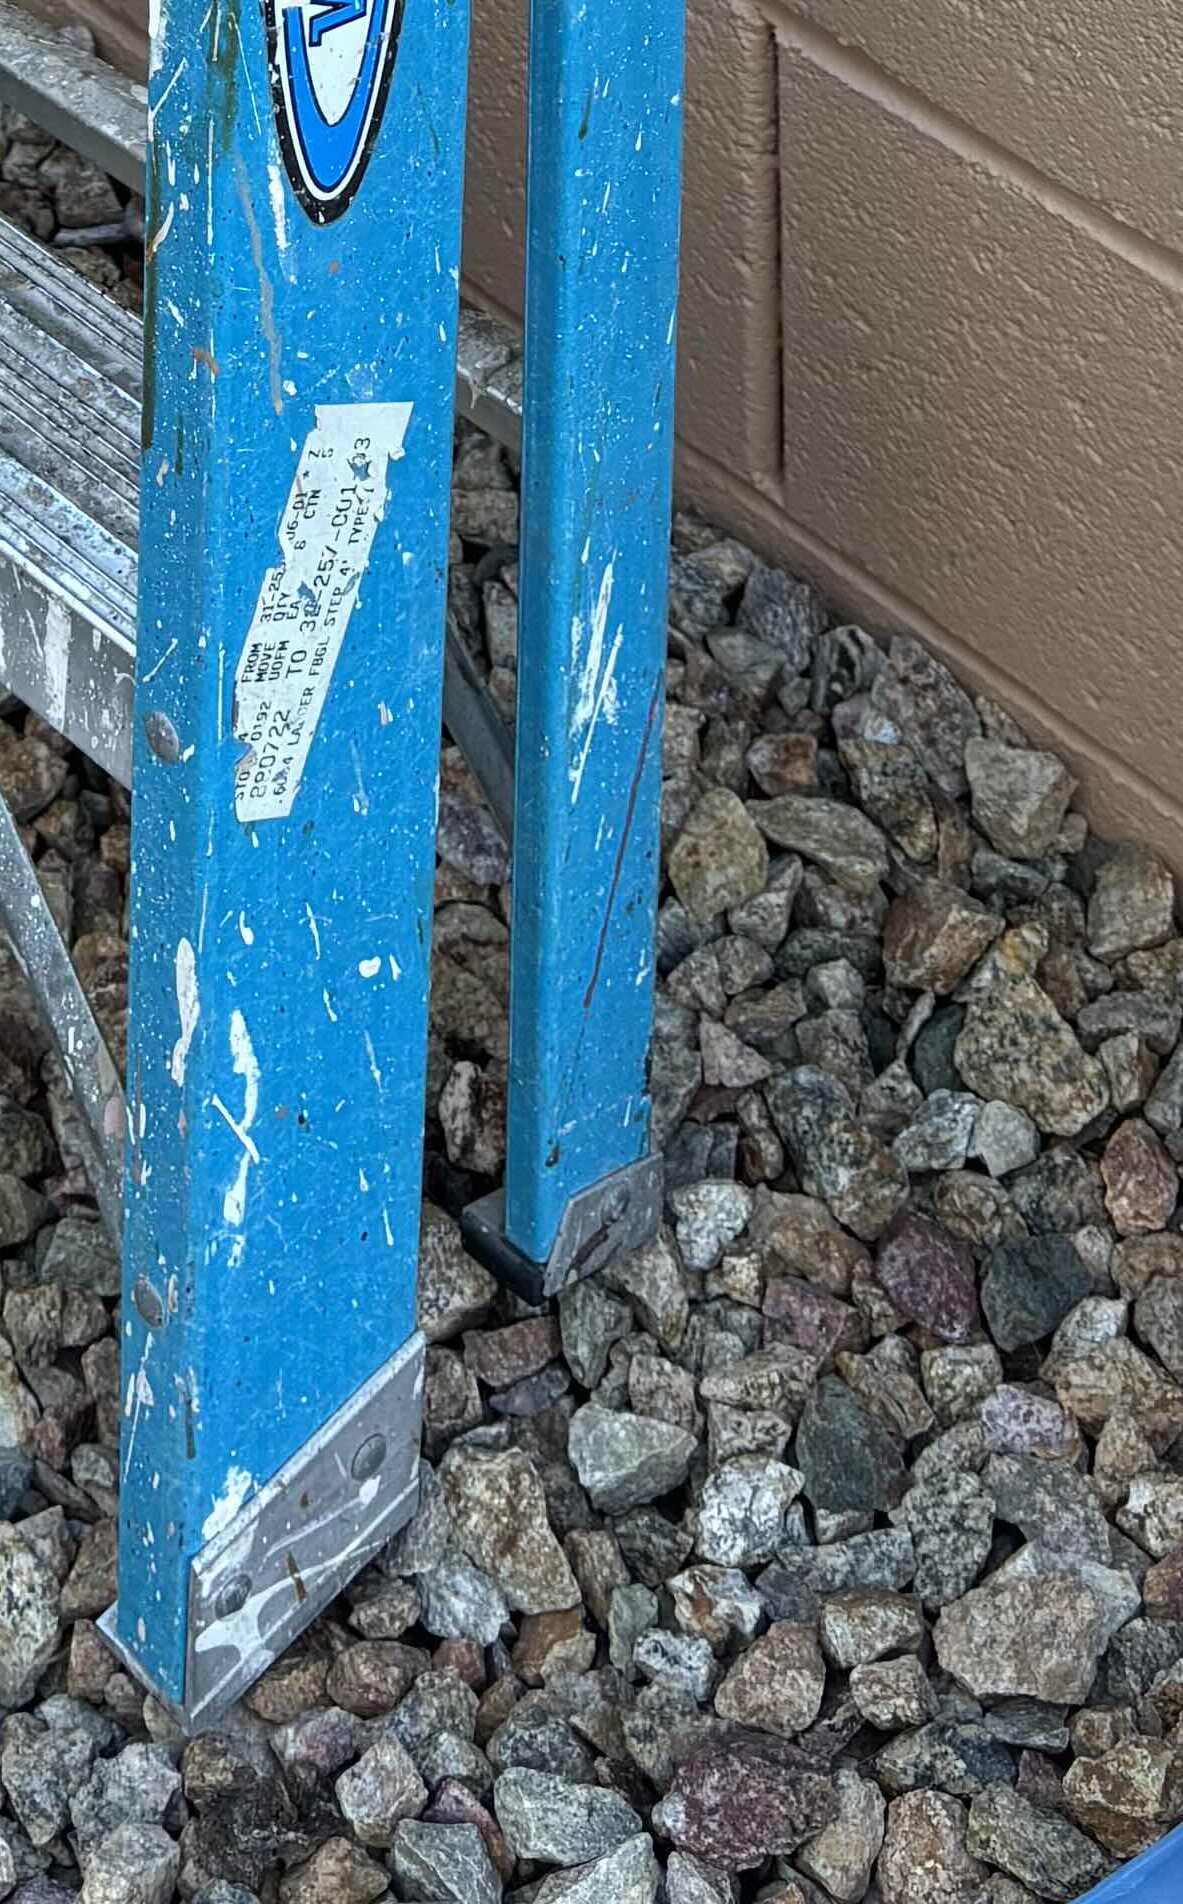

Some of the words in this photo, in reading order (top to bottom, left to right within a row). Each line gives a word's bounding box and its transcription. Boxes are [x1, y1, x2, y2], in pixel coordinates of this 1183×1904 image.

[254, 642, 276, 683] MOVE
[273, 592, 290, 622] QTY
[303, 489, 322, 520] CTN
[323, 586, 342, 627] STEP
[240, 642, 263, 683] FROM
[268, 640, 291, 682] UOFM
[285, 649, 307, 679] TO
